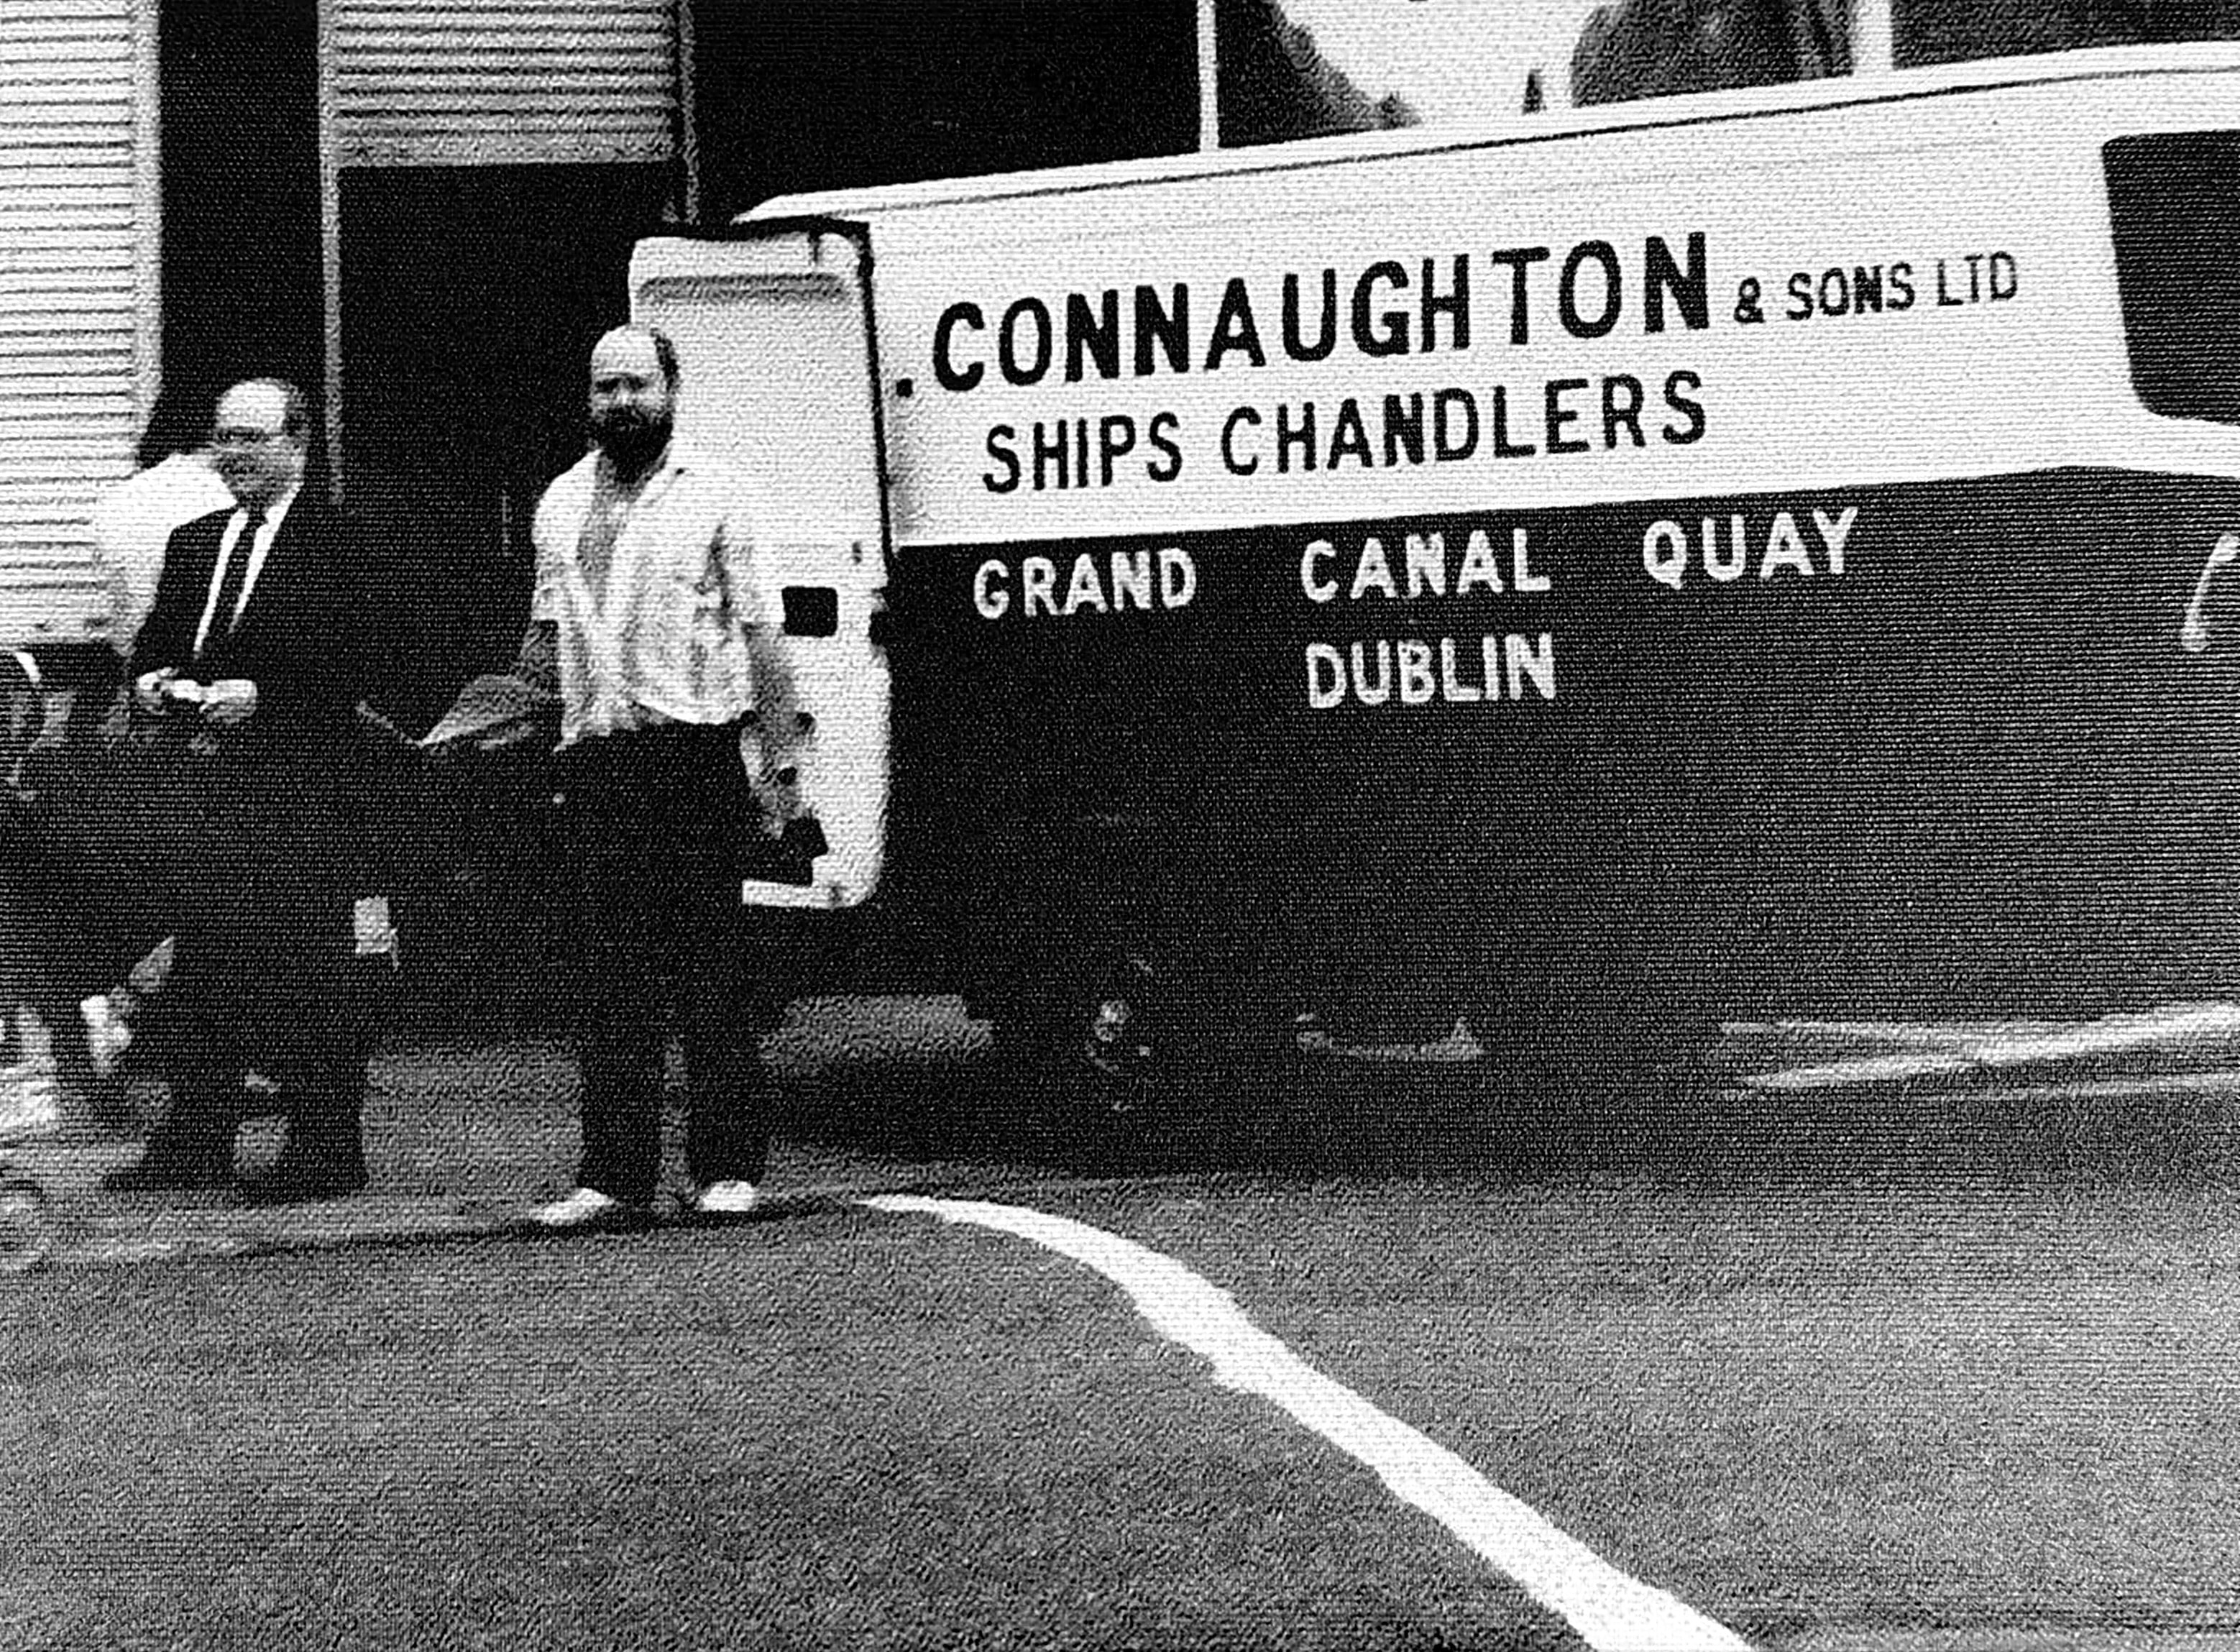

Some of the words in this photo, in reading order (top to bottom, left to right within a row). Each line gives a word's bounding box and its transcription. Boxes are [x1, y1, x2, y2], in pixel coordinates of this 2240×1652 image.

[1733, 276, 1766, 323] &
[1786, 262, 1917, 321] SONS
[1937, 251, 2019, 306] LTD
[983, 411, 1183, 494] SHIPS
[1221, 370, 1706, 476] CHANDLERS
[973, 547, 1197, 619] GRAND
[1300, 527, 1552, 602] CANAL
[1643, 506, 1859, 589] QUAY
[1305, 633, 1556, 709] DUBLIN
